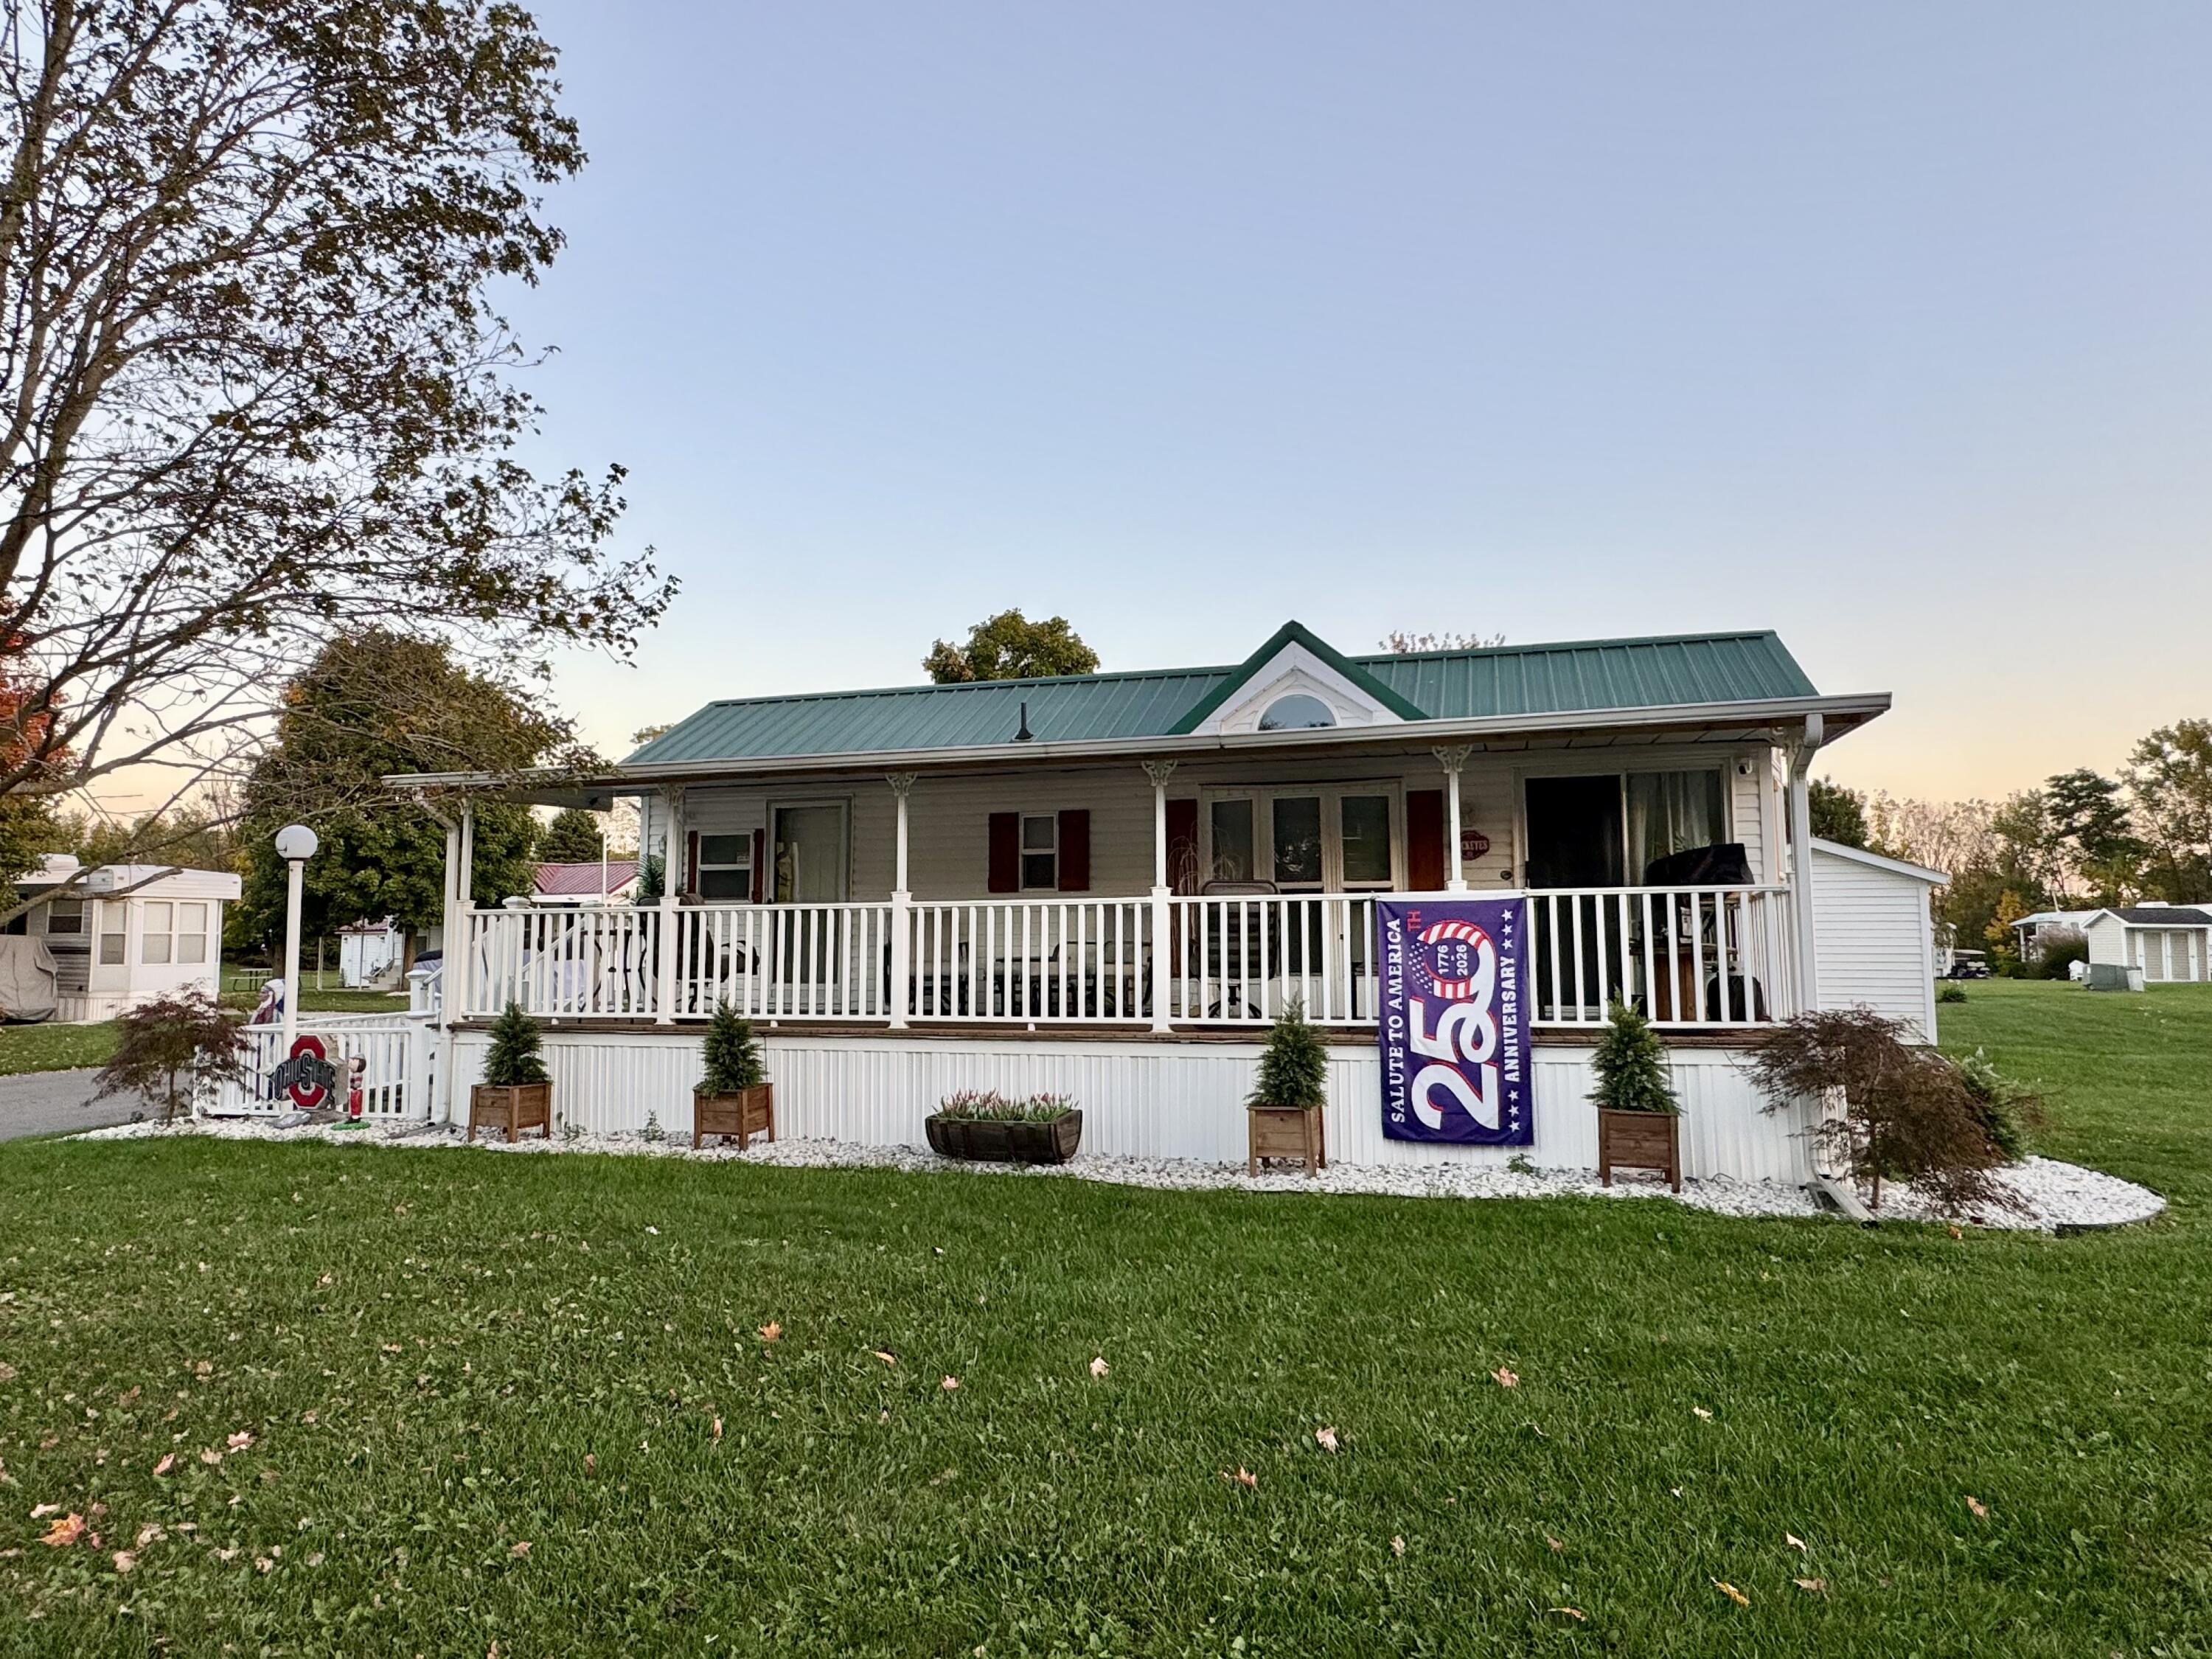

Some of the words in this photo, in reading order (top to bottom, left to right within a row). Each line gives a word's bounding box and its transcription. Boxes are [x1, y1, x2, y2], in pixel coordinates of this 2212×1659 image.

[1387, 918, 1402, 1011] AMERICA
[1437, 945, 1450, 975] 1776
[1455, 944, 1468, 976] 2026
[1388, 1015, 1404, 1041] TO
[1500, 956, 1520, 1083] ANNIVERSARY
[274, 1059, 302, 1100] OHIO
[1389, 1046, 1405, 1123] SALUTE
